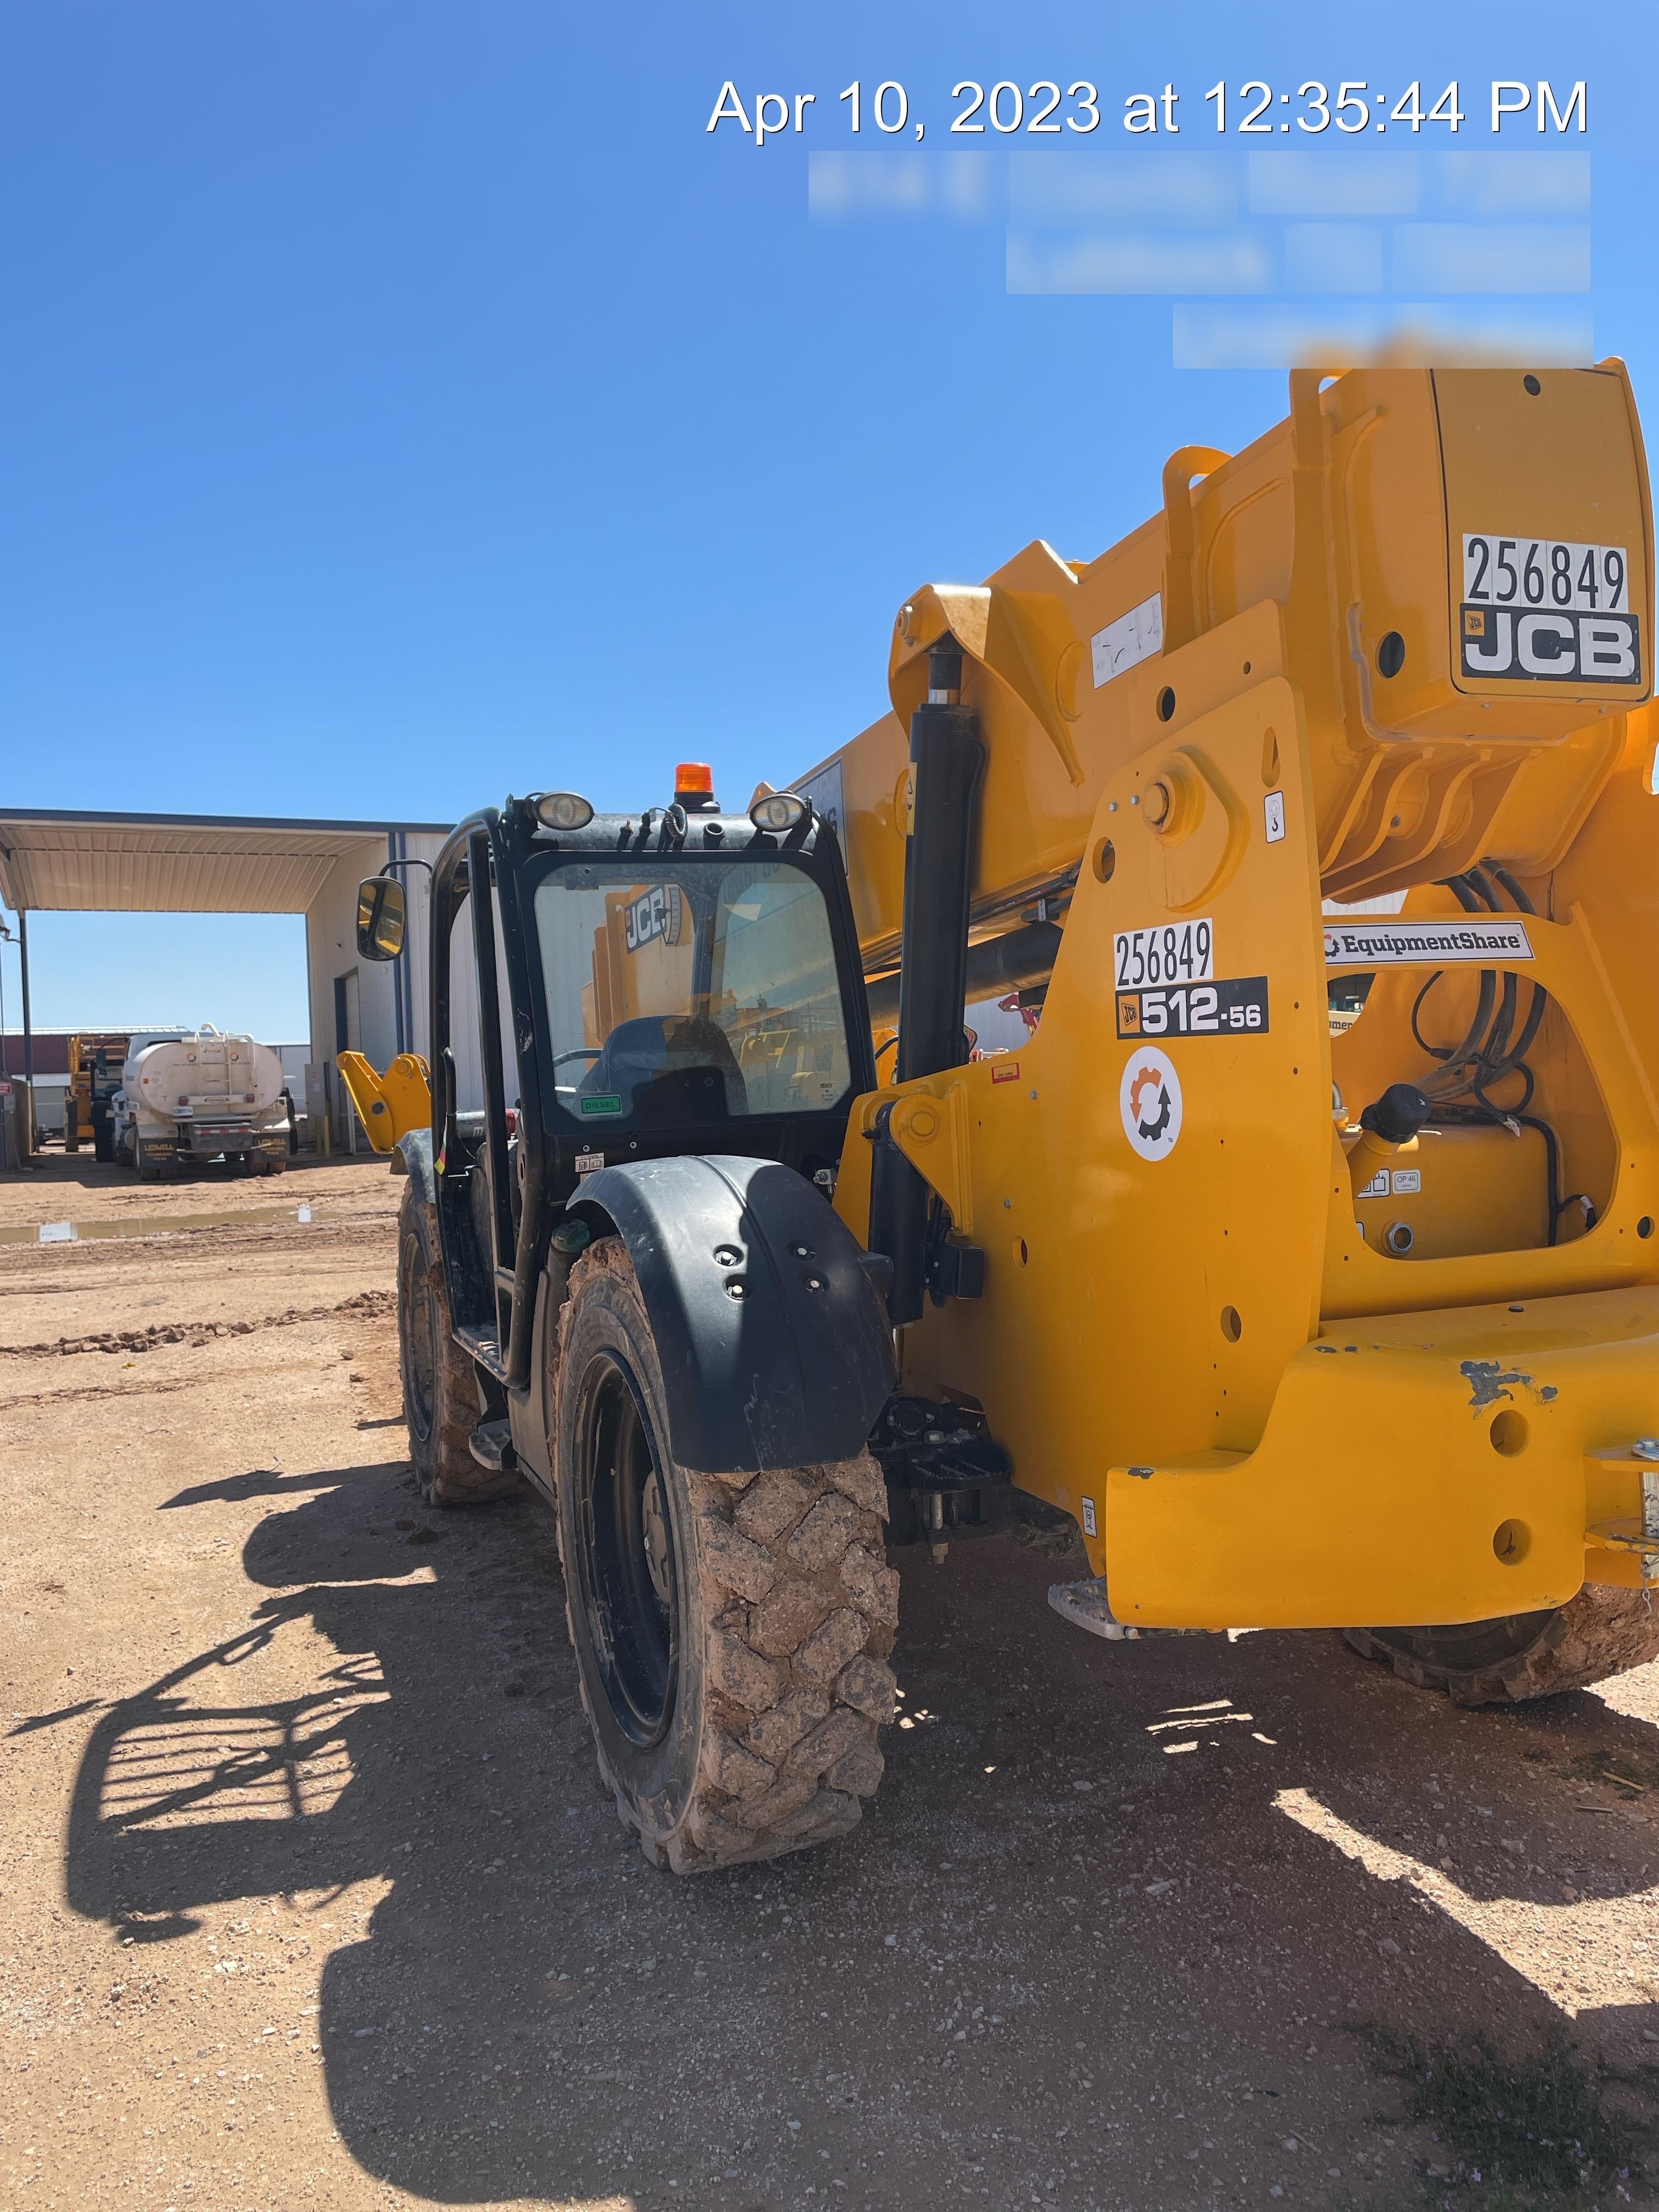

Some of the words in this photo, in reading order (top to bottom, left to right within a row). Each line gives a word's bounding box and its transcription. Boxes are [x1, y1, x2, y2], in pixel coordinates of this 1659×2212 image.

[1468, 537, 1624, 610] 256849
[1465, 612, 1635, 678] JCB
[627, 888, 666, 949] JCB
[1342, 932, 1521, 956] EquipmentShare
[1116, 921, 1210, 986] 256849
[1123, 1003, 1137, 1025] JCB
